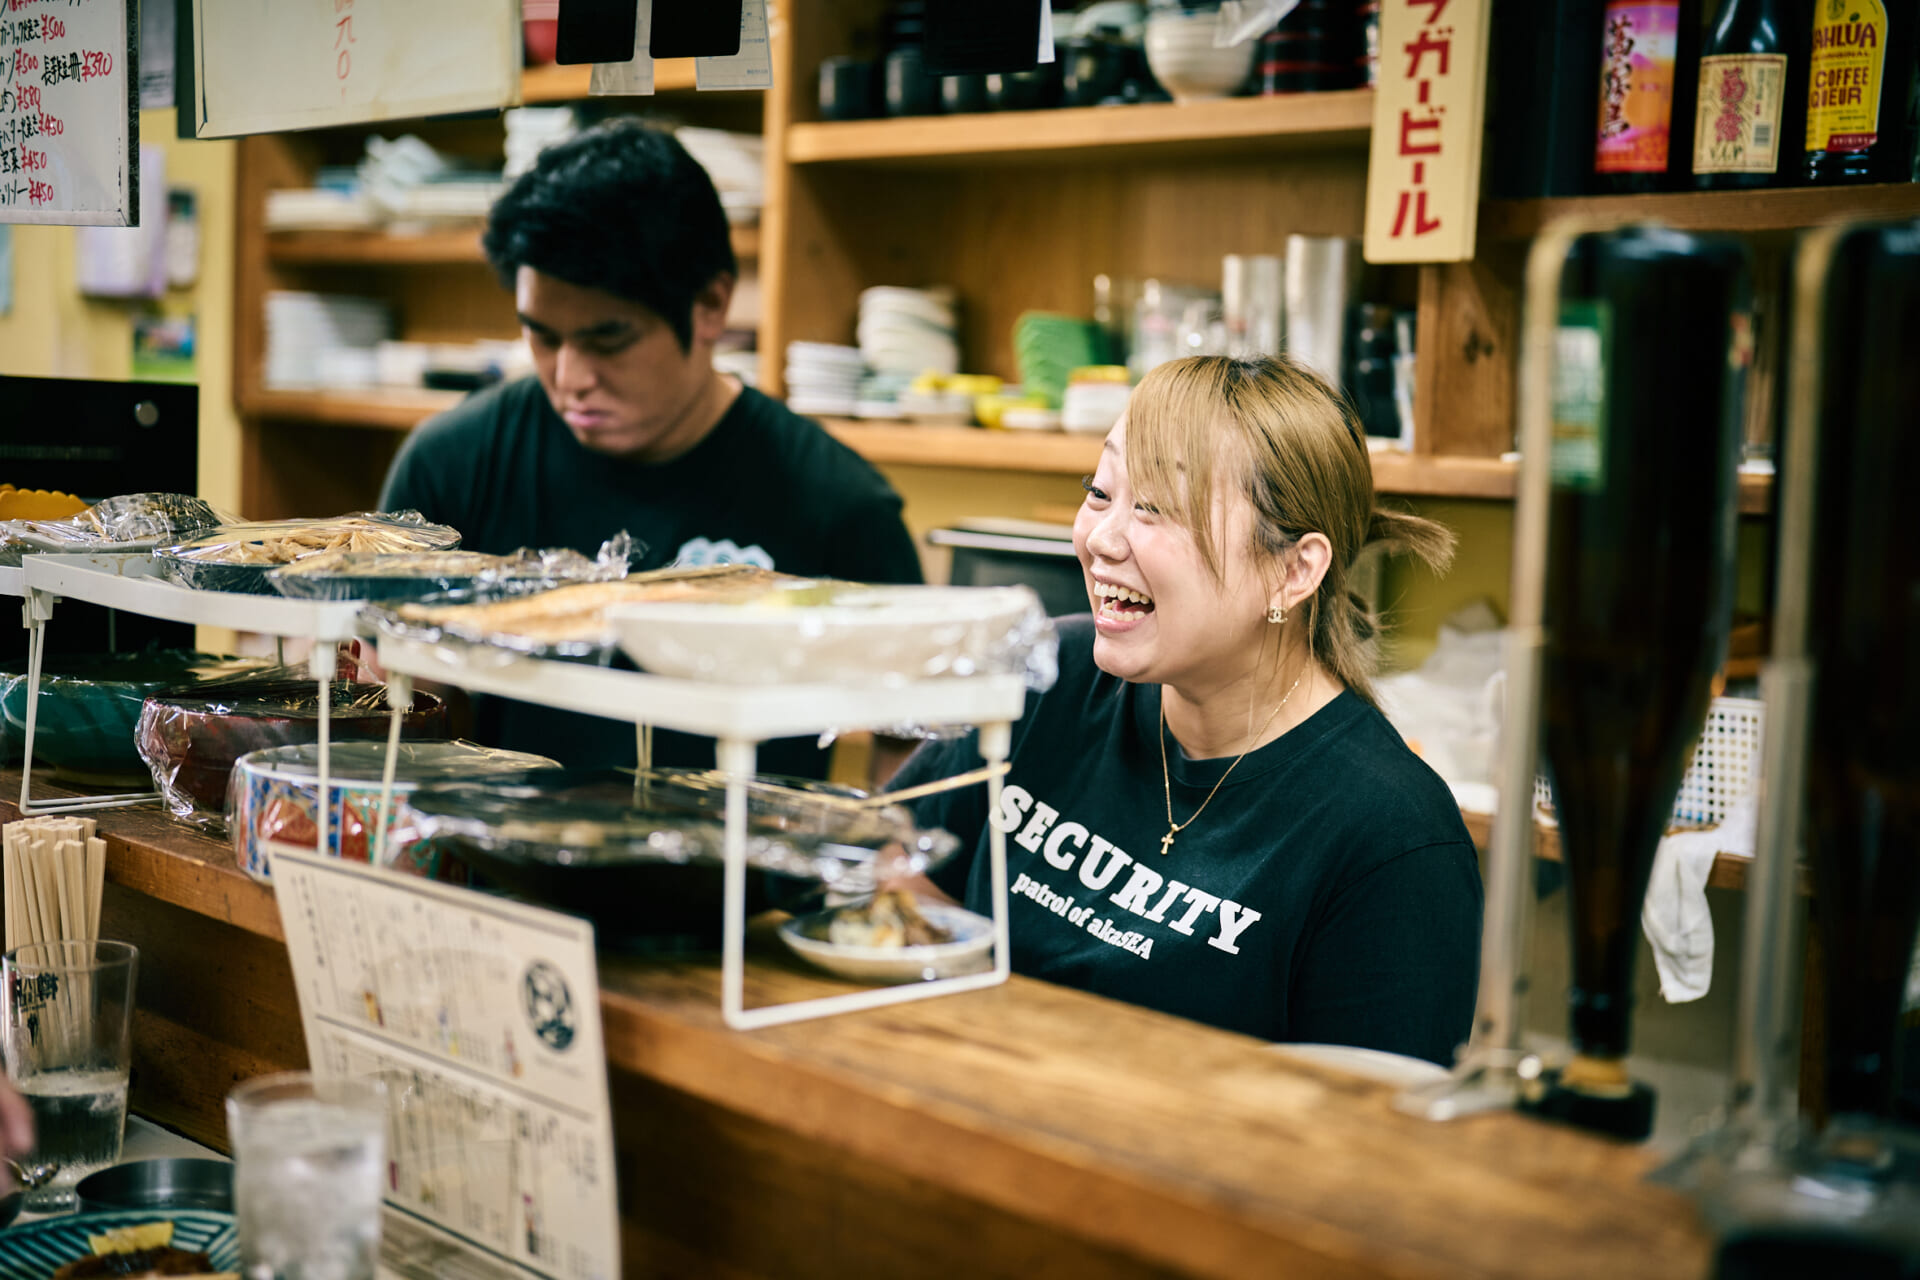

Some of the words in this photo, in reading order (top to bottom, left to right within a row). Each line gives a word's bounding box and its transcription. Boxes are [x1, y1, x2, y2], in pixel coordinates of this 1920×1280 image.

[15, 47, 39, 76] ¥500
[81, 49, 113, 83] ¥390
[1815, 67, 1869, 88] COFFEE
[16, 81, 41, 111] ¥580
[1810, 87, 1862, 108] QUEUR
[20, 142, 47, 174] ¥450
[28, 177, 54, 206] ¥450
[988, 785, 1261, 955] SECURITY
[1010, 872, 1075, 917] patrol
[1067, 906, 1096, 928] of
